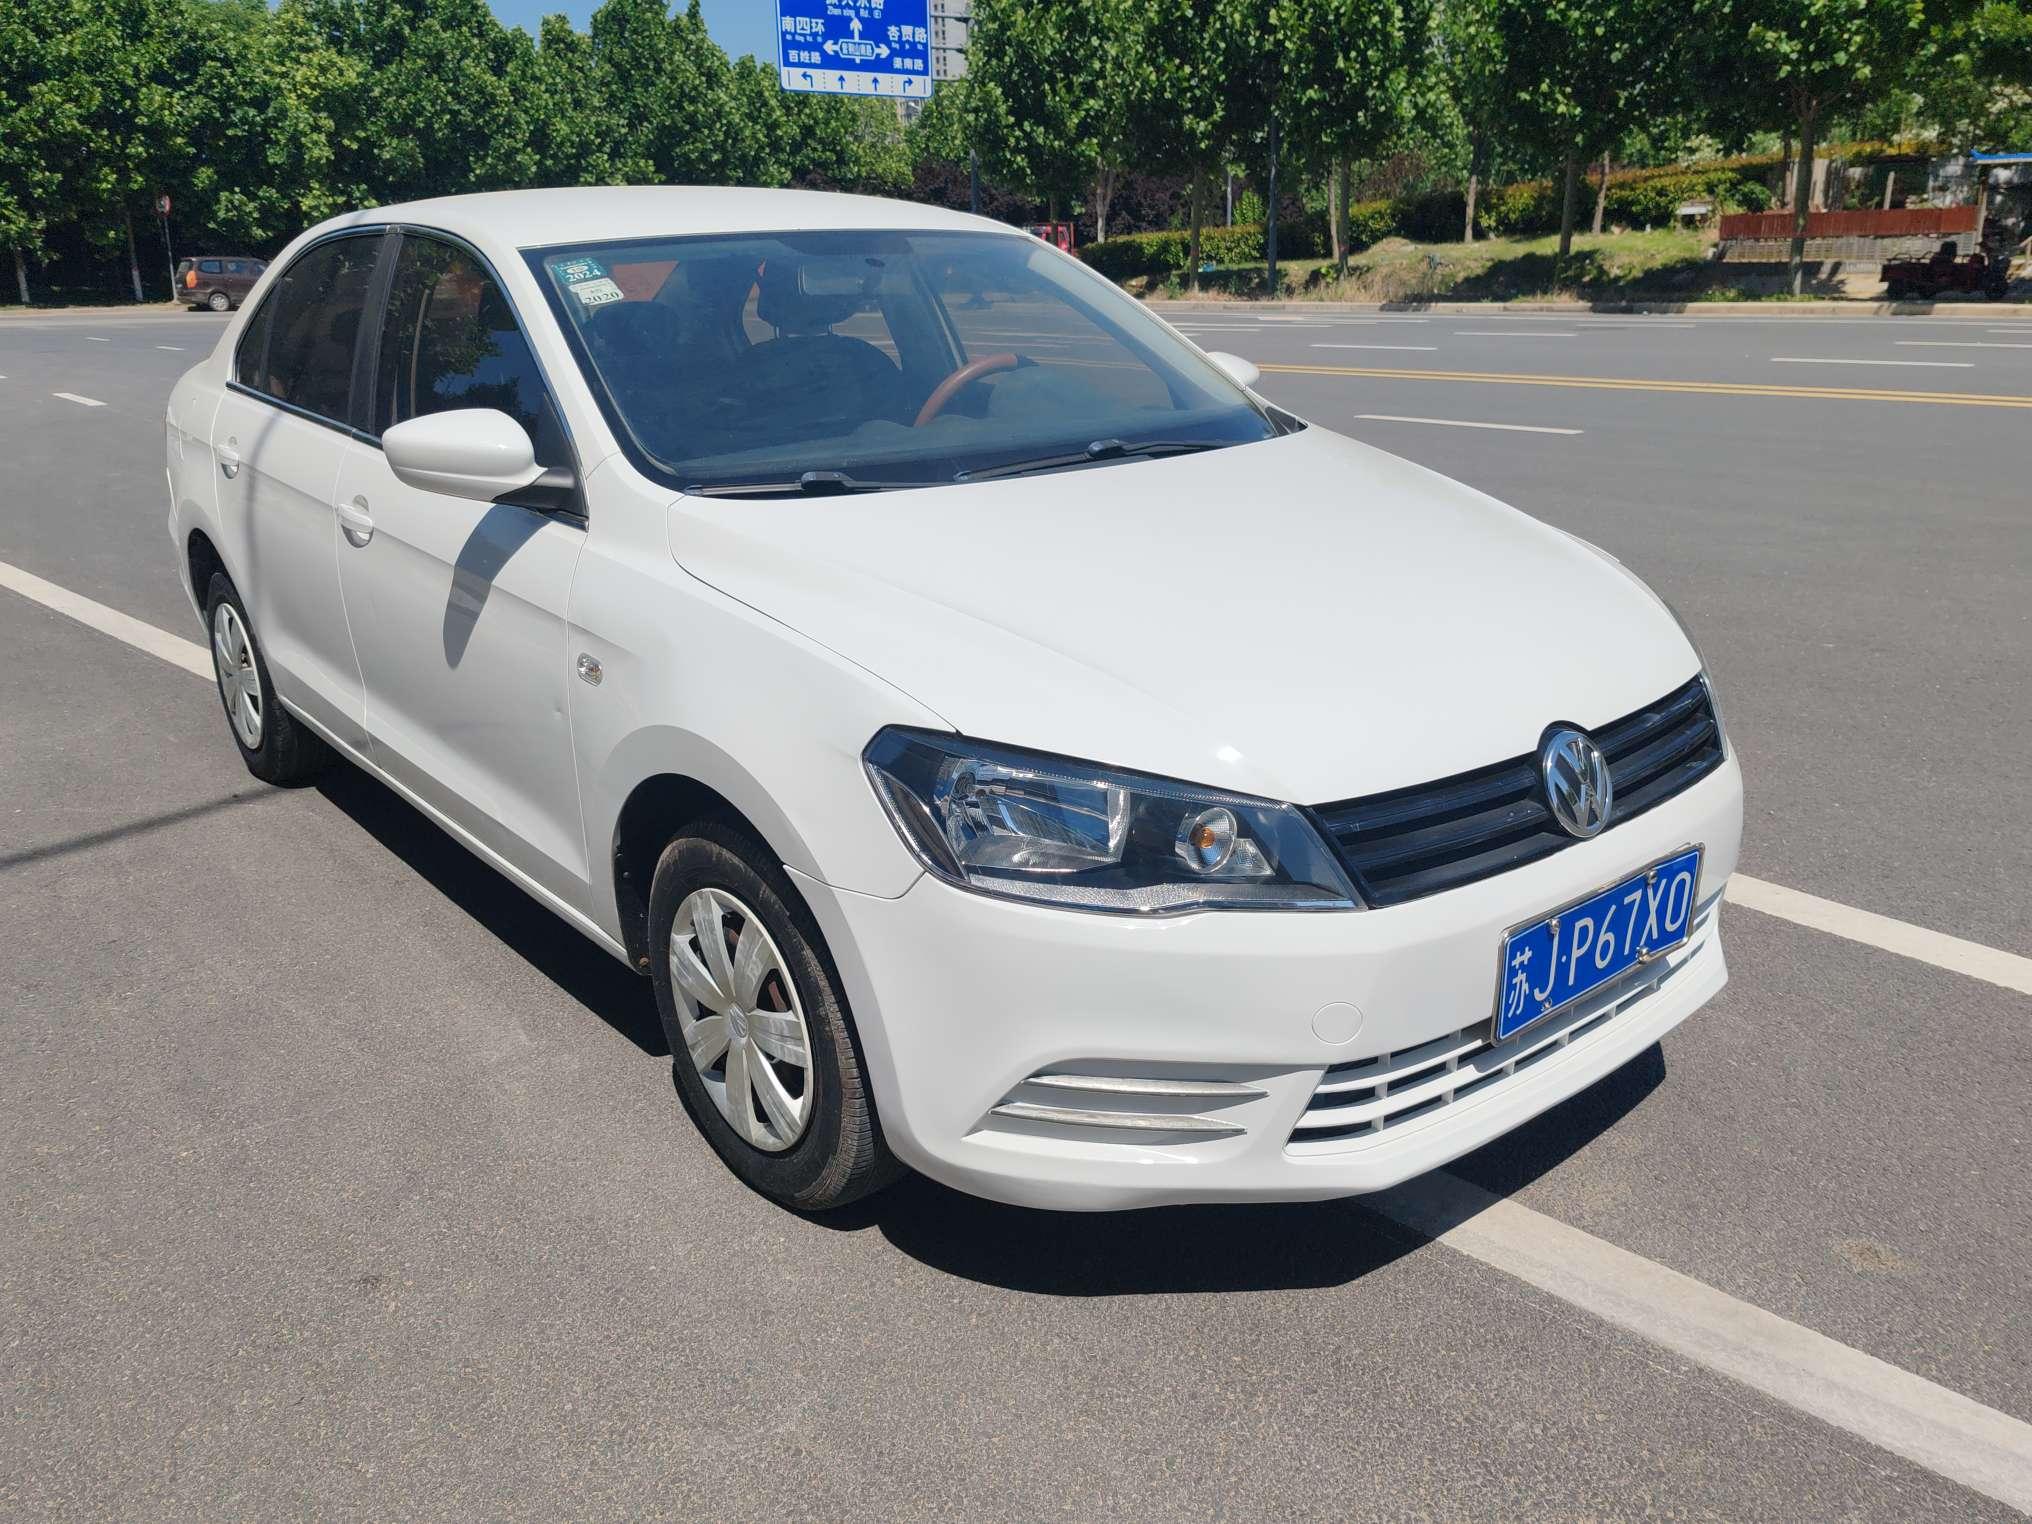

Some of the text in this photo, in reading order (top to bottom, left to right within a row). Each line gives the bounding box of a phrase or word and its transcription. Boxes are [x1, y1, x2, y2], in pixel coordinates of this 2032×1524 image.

[781, 16, 825, 35] 南四环
[565, 269, 601, 282] 2024
[584, 291, 619, 305] 2020
